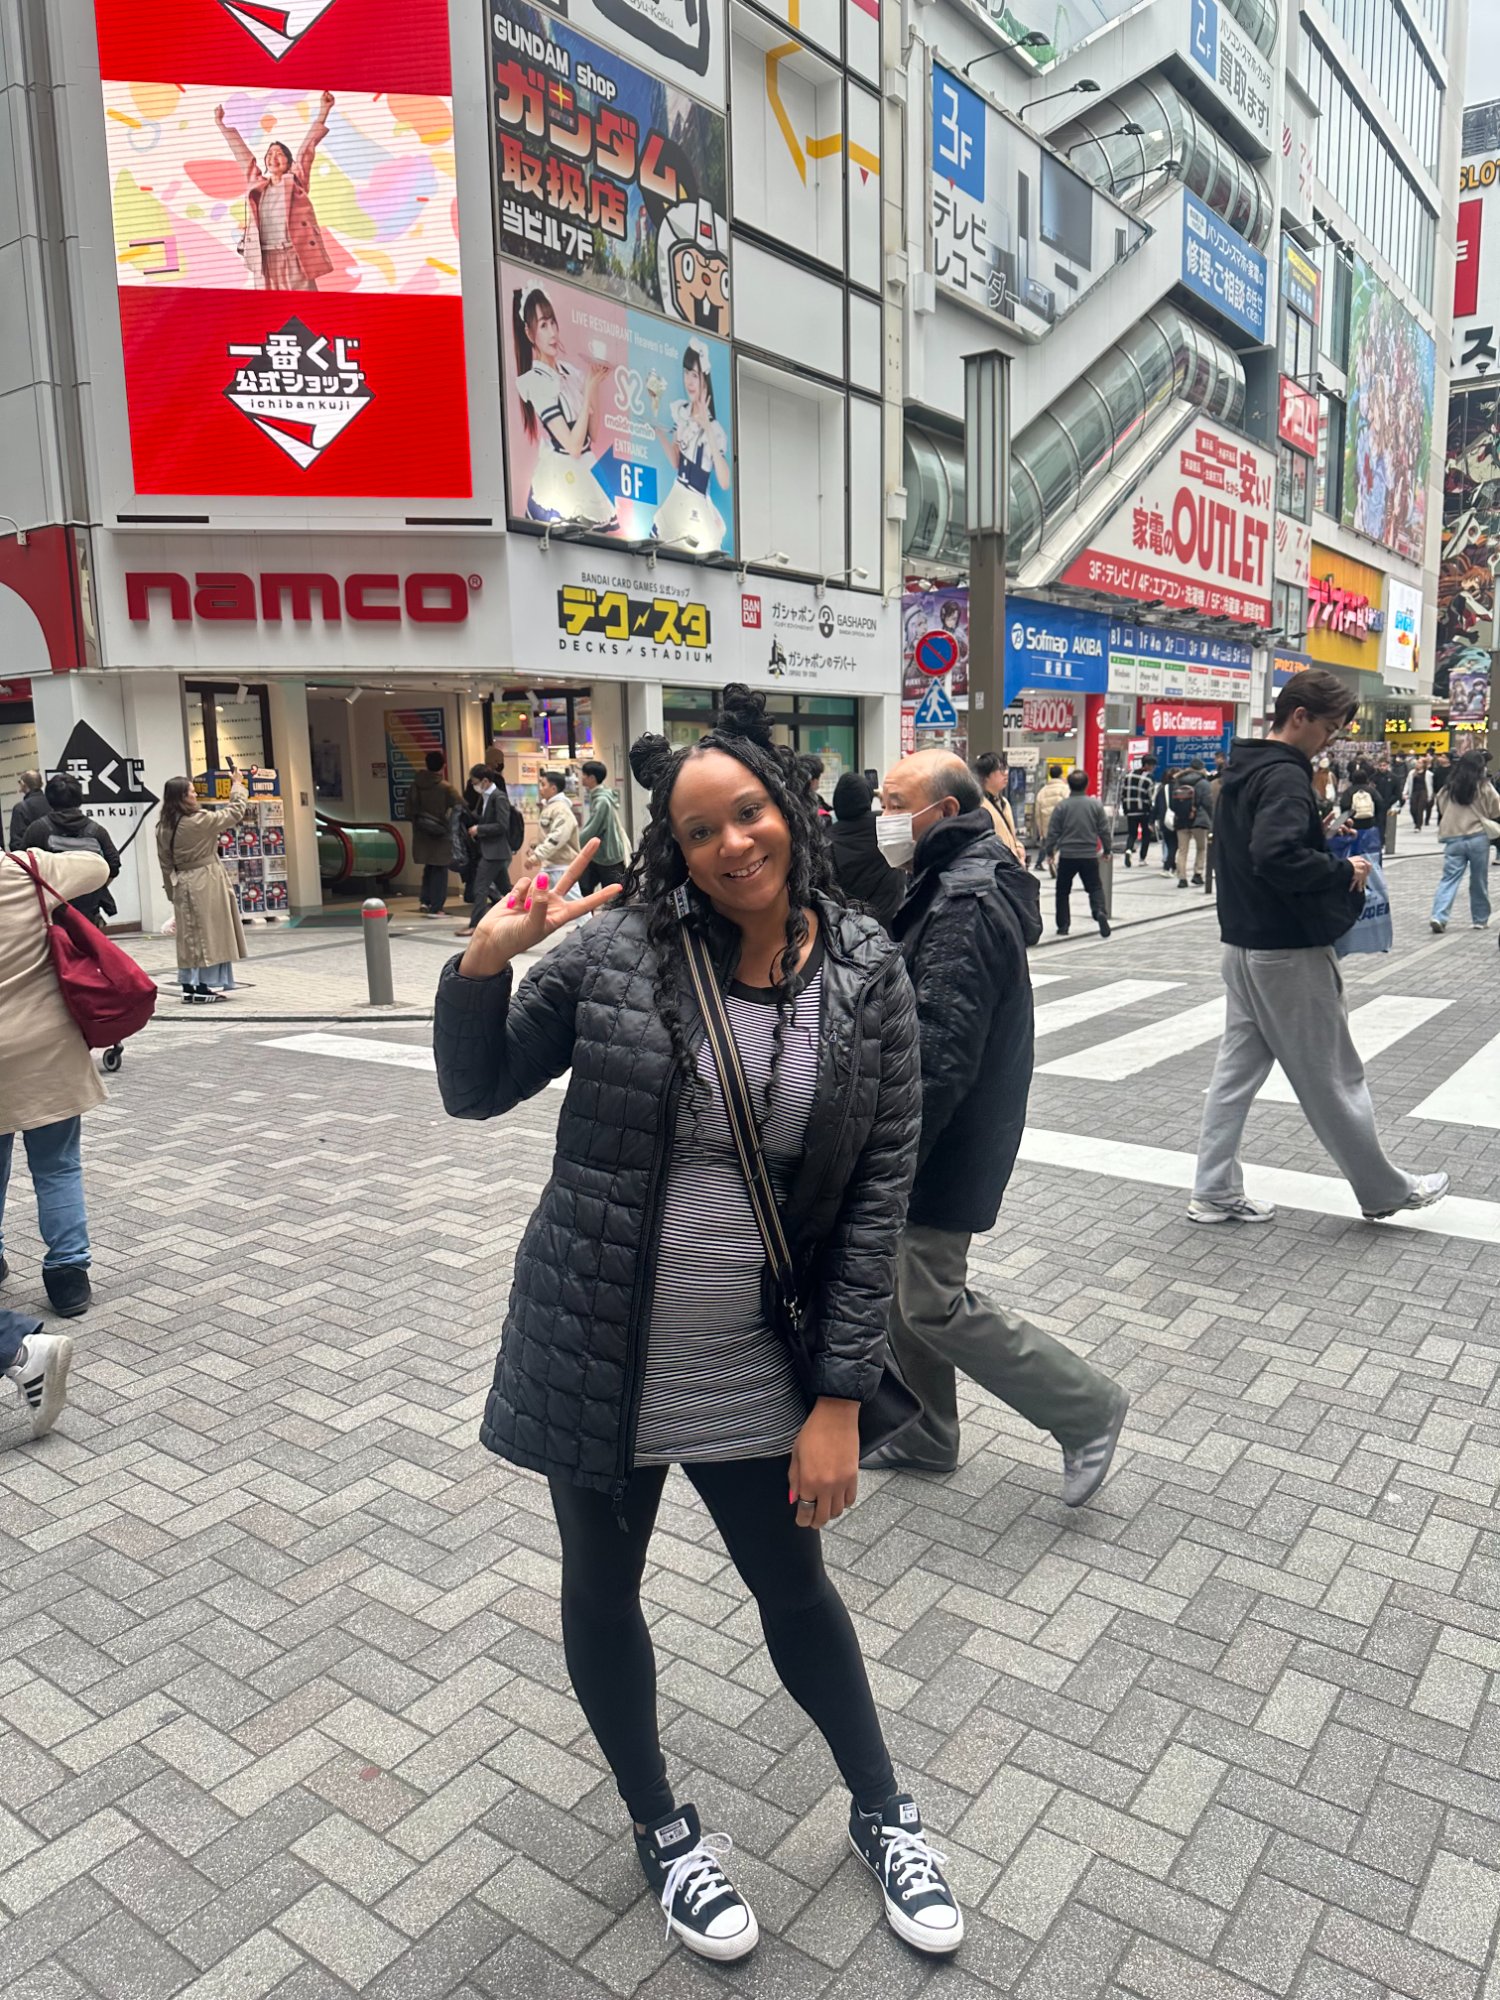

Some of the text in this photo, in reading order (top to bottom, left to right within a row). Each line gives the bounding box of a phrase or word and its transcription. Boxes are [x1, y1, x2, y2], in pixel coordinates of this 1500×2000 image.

[631, 0, 673, 29] yu-Kaku
[493, 13, 617, 100] GUNDAM shop
[497, 58, 678, 203] ガンダム
[939, 83, 973, 170] 3F
[500, 132, 627, 239] 取扱店
[1459, 159, 1500, 191] SLO
[502, 199, 593, 261] 当ビル7F
[933, 188, 987, 257] テレビ
[934, 236, 1021, 309] レコーダー
[1187, 236, 1245, 315] 修理・ご相談
[572, 309, 588, 328] LIVE
[589, 315, 633, 343] RESTAURANT
[227, 332, 360, 371] 一番くじ
[236, 370, 365, 395] 公式ショップ
[250, 397, 351, 411] ichibankuji
[1282, 377, 1316, 444] アコム
[614, 437, 649, 460] ENTRANCE
[620, 462, 644, 499] 6F
[581, 572, 610, 586] BANDAI
[611, 577, 632, 590] CARD
[633, 580, 658, 593] GAMES
[772, 602, 877, 631] ガシャポン GASHAPON
[559, 639, 713, 663] DECKS STADIUM
[1026, 627, 1102, 658] Sofmap AKIBA
[1140, 631, 1149, 650] 1F
[1165, 636, 1174, 653] 2F
[788, 651, 857, 672] ガシャポンのデパート
[82, 807, 138, 817] ankuji
